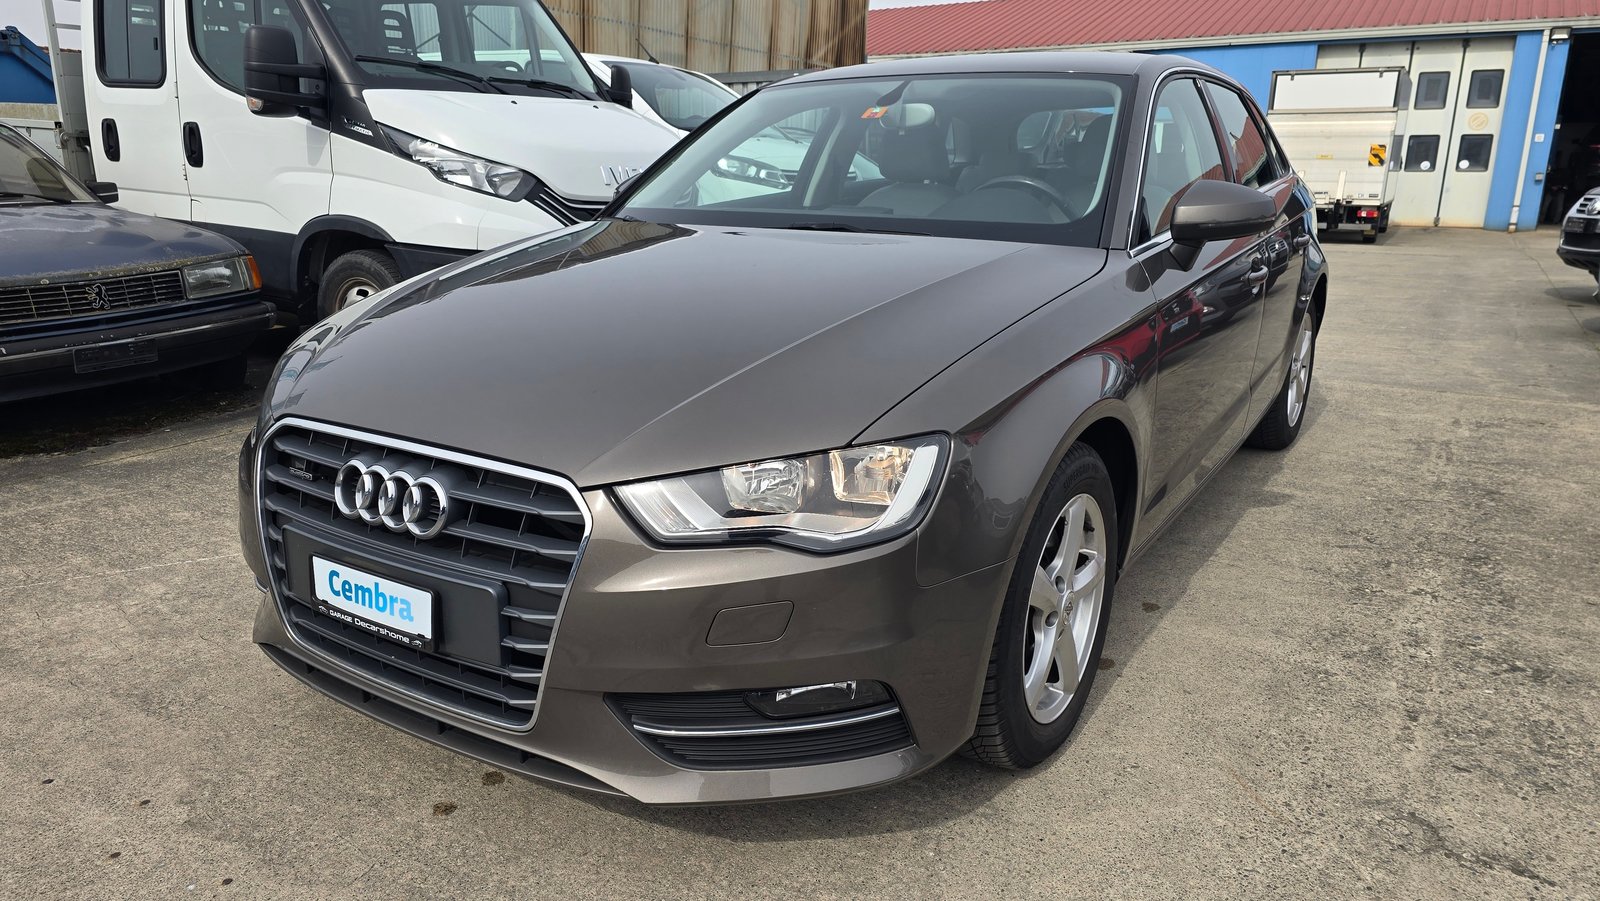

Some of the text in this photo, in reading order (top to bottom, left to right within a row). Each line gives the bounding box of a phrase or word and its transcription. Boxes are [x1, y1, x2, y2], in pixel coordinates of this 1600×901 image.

[328, 569, 414, 622] Cembra
[329, 609, 410, 644] GARAGE Decarshome
